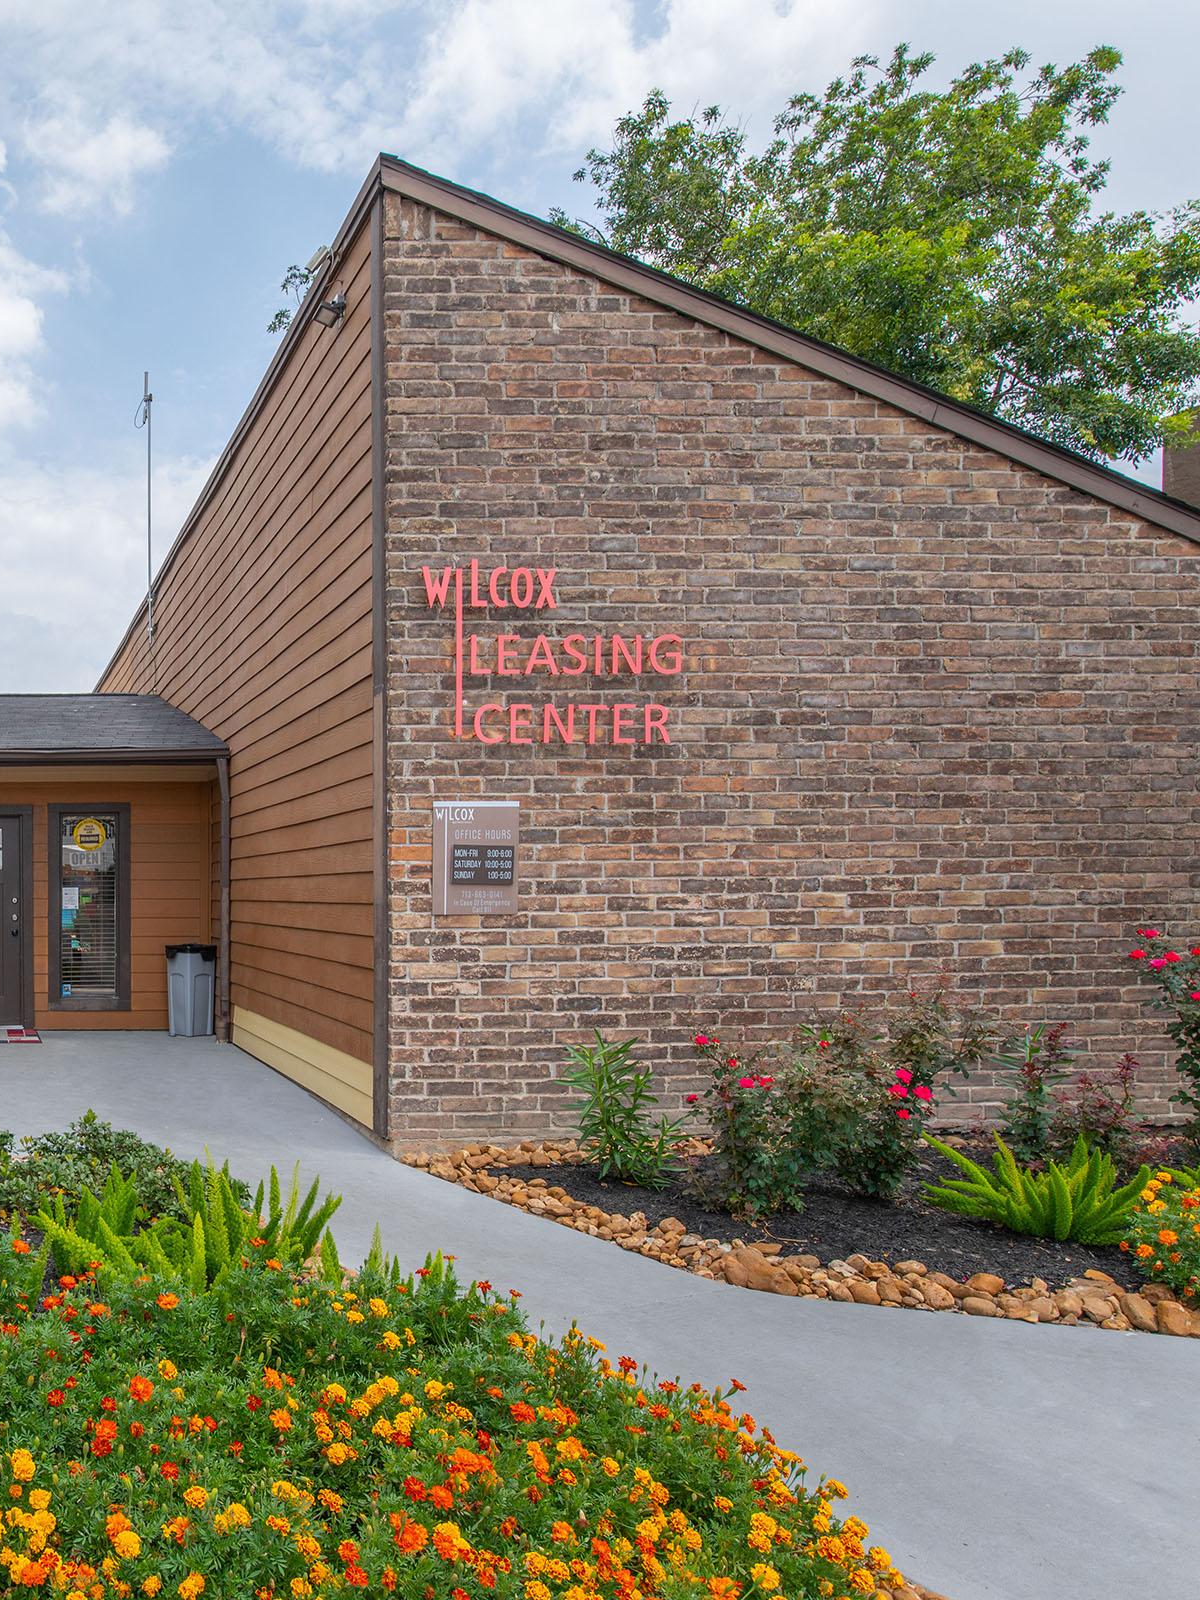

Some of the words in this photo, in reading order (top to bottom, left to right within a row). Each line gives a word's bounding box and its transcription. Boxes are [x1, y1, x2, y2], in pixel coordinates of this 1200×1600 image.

[422, 559, 557, 609] WILCOX
[470, 634, 683, 675] LEASING
[473, 703, 671, 744] CENTER
[436, 806, 474, 820] WILCOX
[454, 830, 482, 840] OFFICE
[485, 830, 512, 840] HOURS
[71, 852, 99, 865] OPEN
[454, 849, 478, 857] MON-FRI
[454, 860, 482, 868] SATURDAY
[453, 870, 476, 879] SUNDAY
